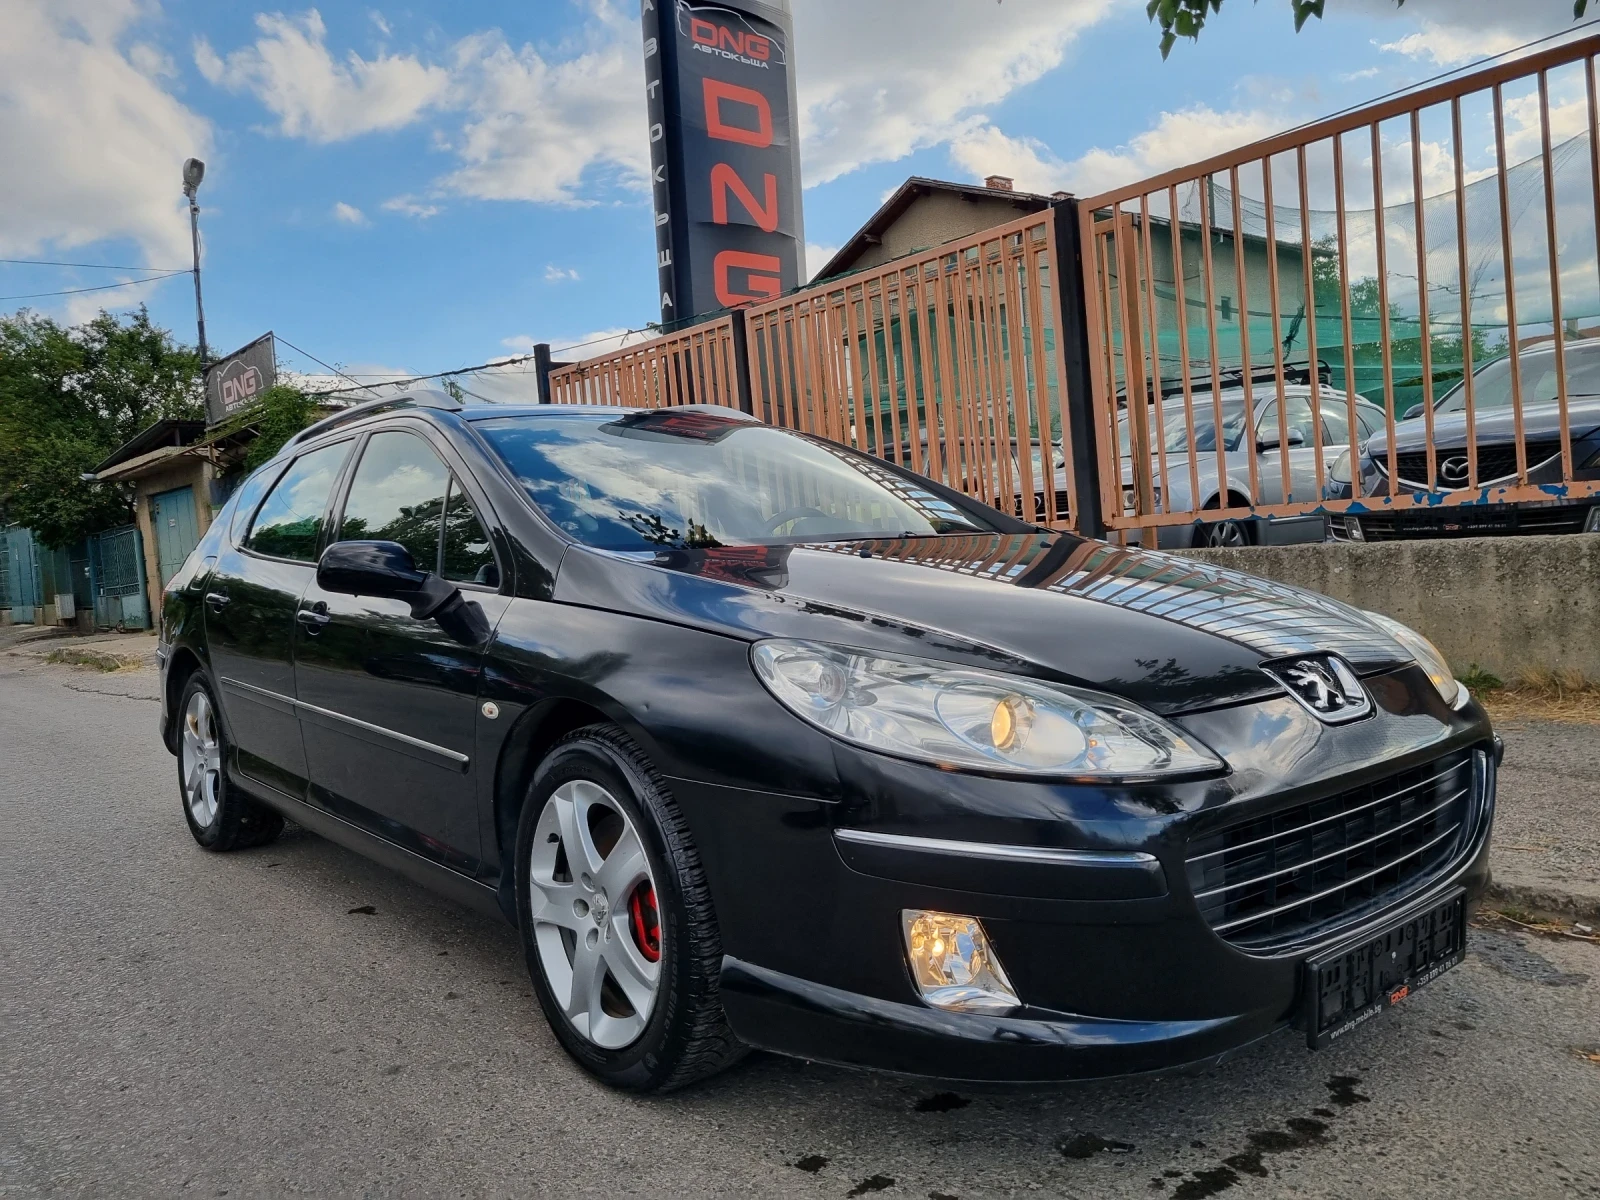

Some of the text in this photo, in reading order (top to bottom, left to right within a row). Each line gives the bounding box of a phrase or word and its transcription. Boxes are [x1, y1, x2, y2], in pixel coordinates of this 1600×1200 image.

[690, 17, 770, 61] DNG
[692, 43, 770, 70] АВТОКЪША
[701, 77, 781, 311] DNG
[222, 369, 256, 405] DNG
